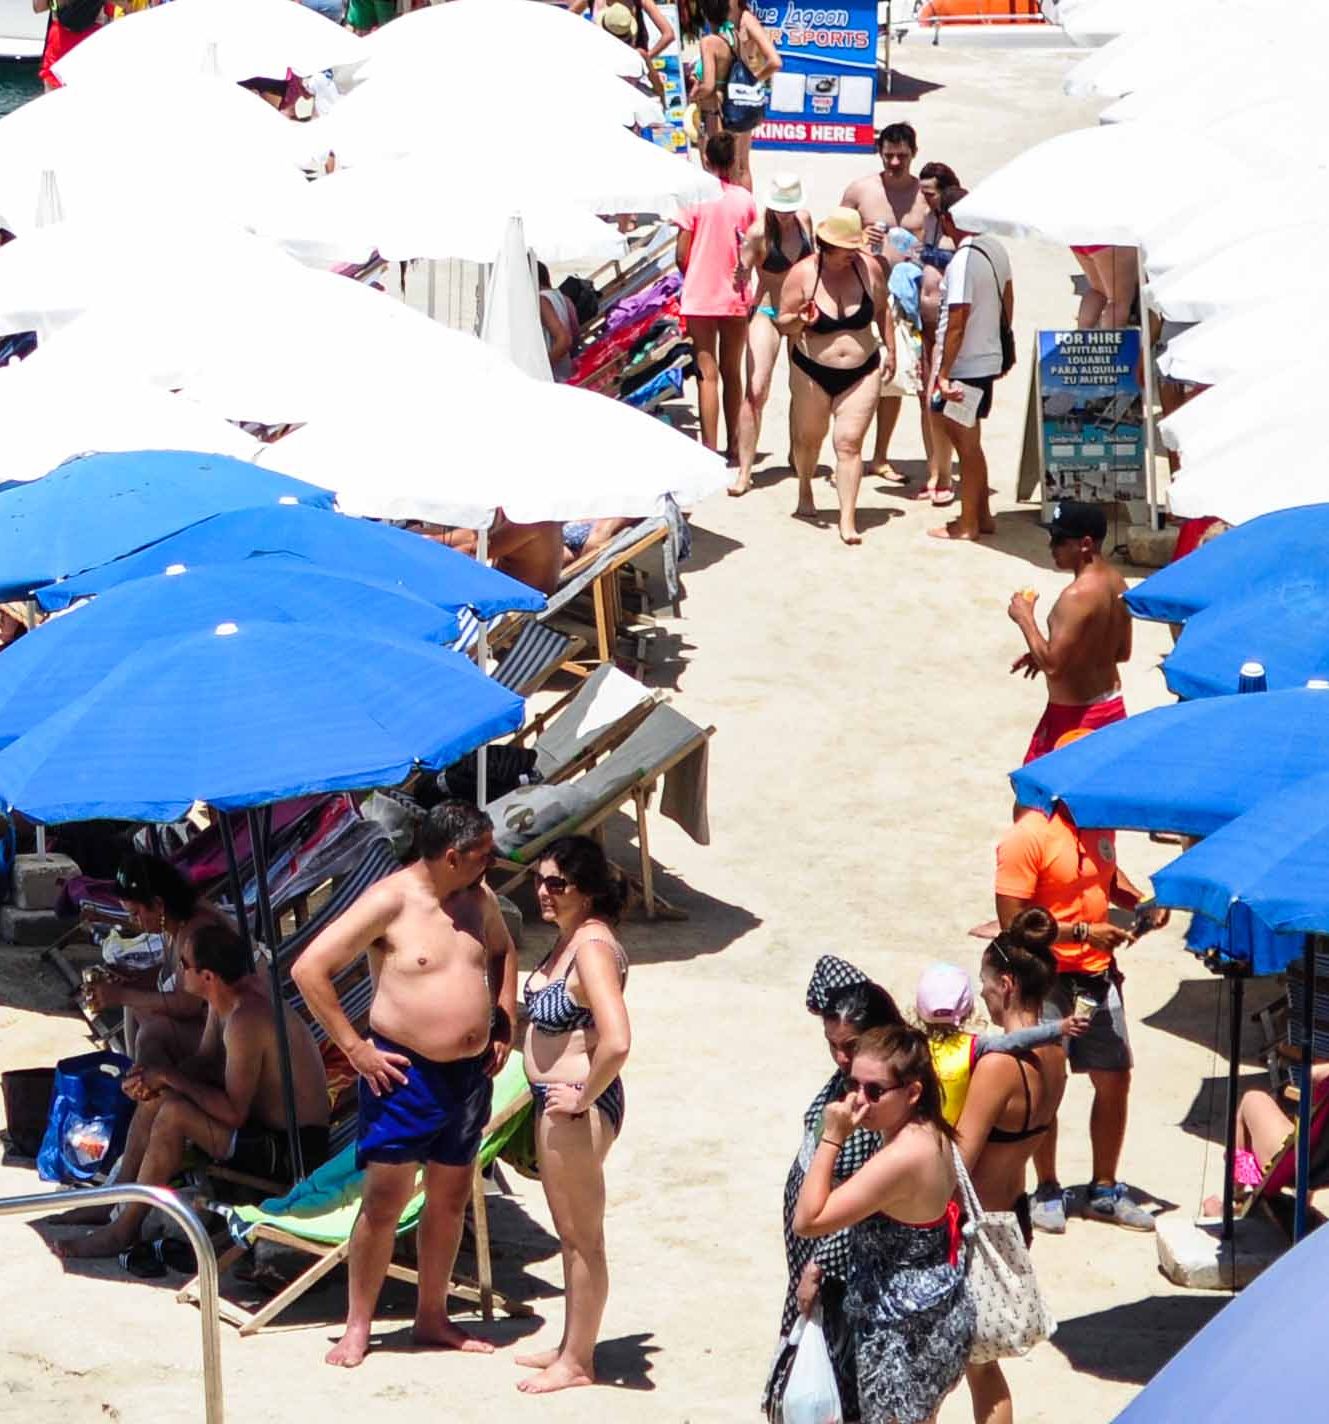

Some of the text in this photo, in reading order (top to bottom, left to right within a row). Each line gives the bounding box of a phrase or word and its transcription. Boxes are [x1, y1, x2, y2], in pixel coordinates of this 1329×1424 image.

[750, 0, 779, 24] lue
[788, 29, 869, 49] SPORTS
[810, 125, 856, 142] HERE
[1054, 332, 1123, 345] FOR HIRE
[1050, 365, 1079, 375] PARA
[1062, 375, 1077, 385] ZU
